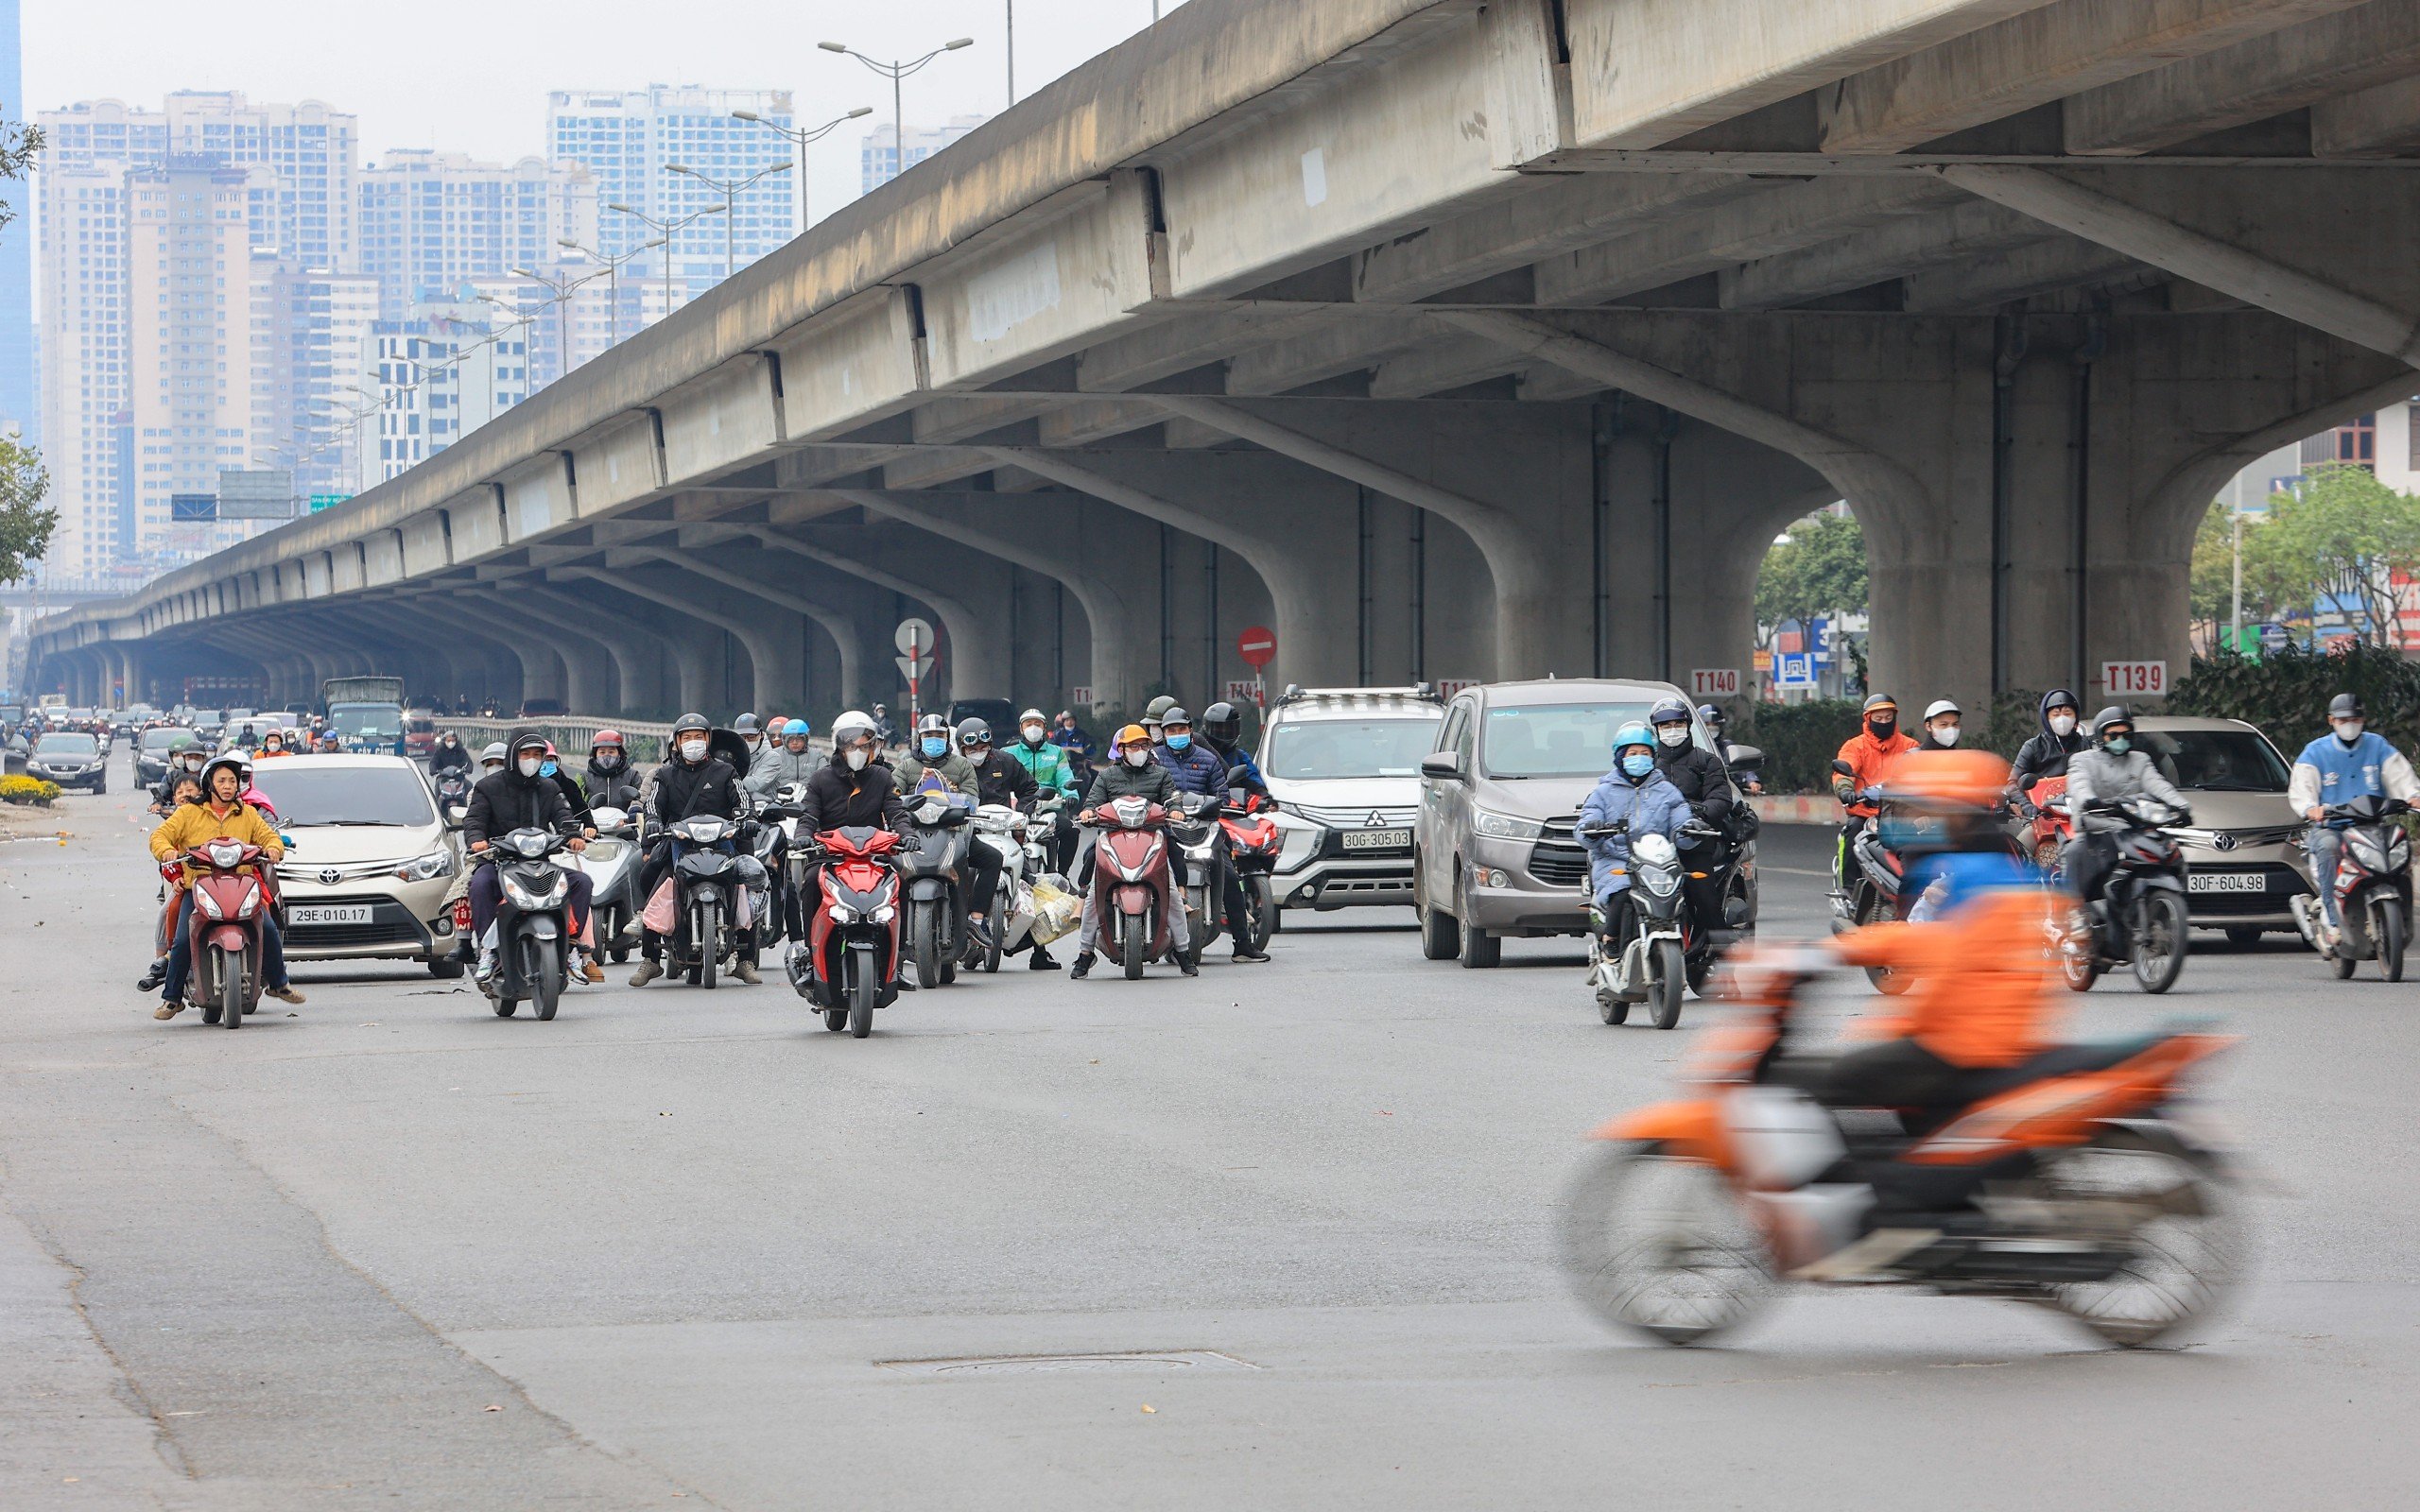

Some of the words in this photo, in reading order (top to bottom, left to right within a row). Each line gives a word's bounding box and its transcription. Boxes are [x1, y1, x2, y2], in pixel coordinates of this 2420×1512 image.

[1695, 671, 1736, 693] T140
[2107, 665, 2161, 691] T139
[1344, 833, 1409, 847] 30G-305.03
[2190, 875, 2264, 890] 30F-604.98
[296, 909, 366, 921] 29E-010.17
